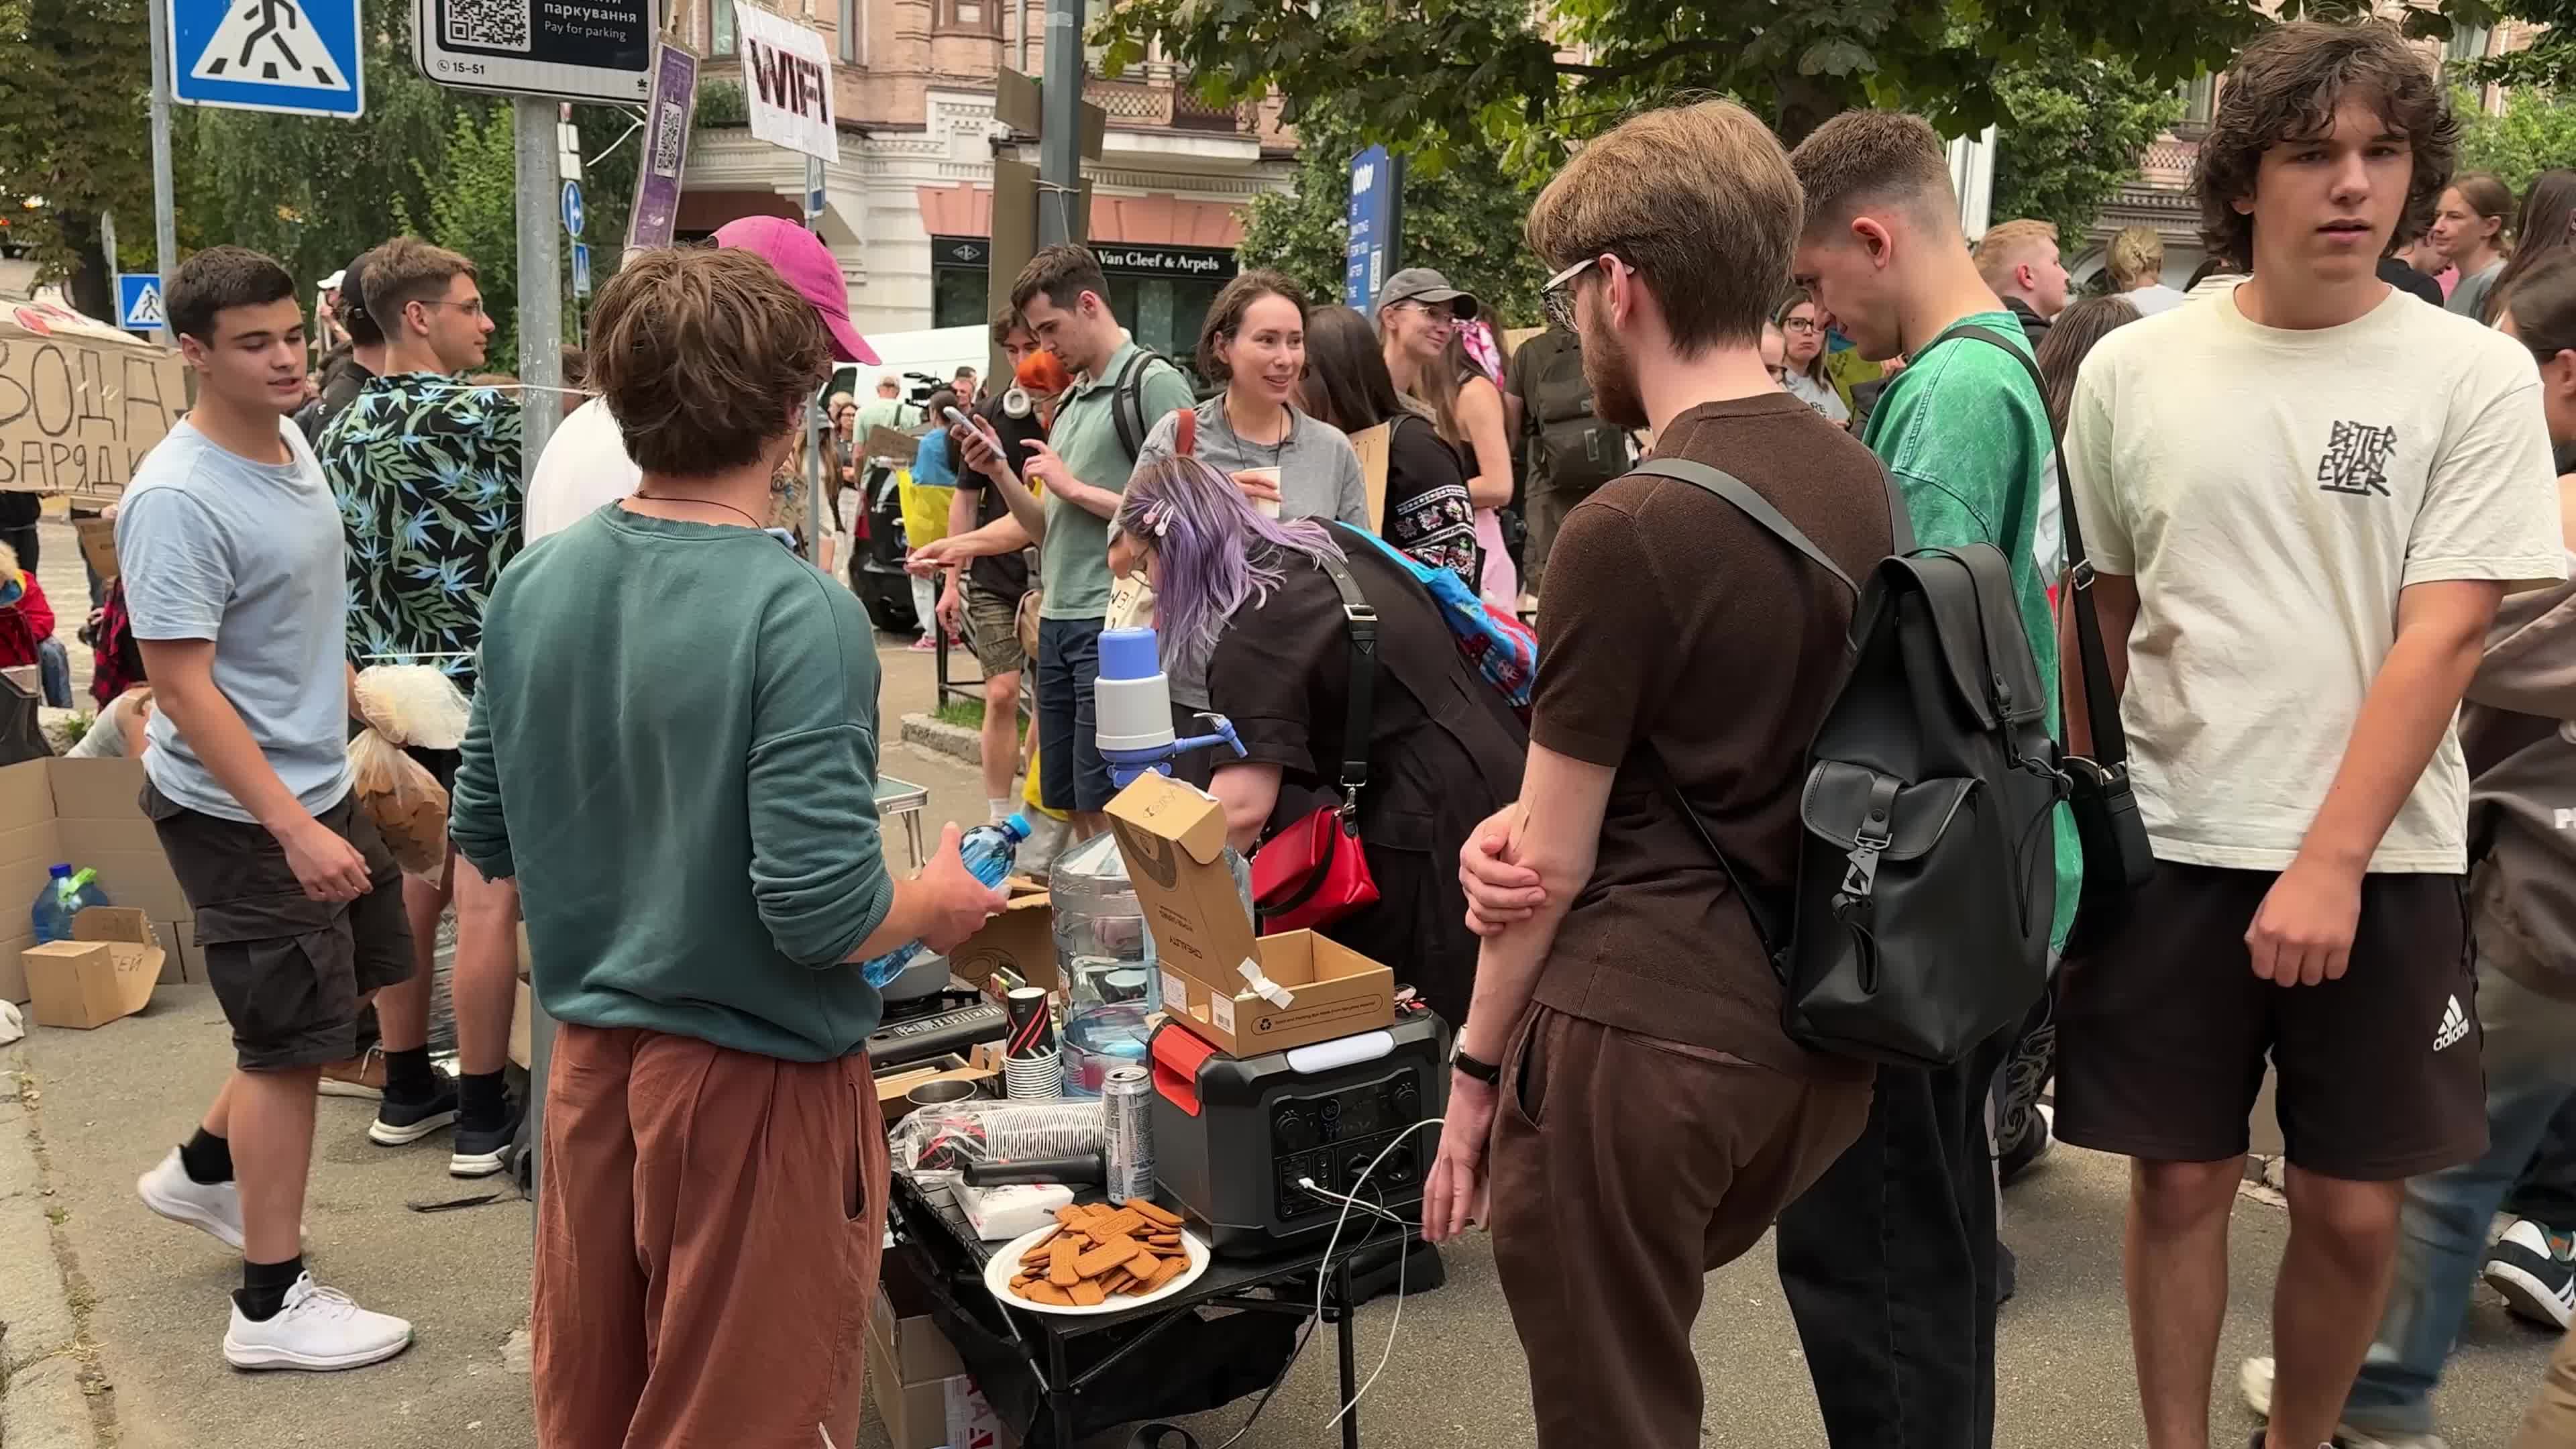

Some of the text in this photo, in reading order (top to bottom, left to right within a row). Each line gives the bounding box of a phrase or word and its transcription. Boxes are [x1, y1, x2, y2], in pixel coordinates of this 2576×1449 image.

[544, 3, 637, 23] паркування
[545, 21, 627, 42] Pay for parking
[453, 62, 484, 75] 15-51
[748, 38, 828, 125] WIFI
[1097, 250, 1219, 273] Van Cleef & Arpels
